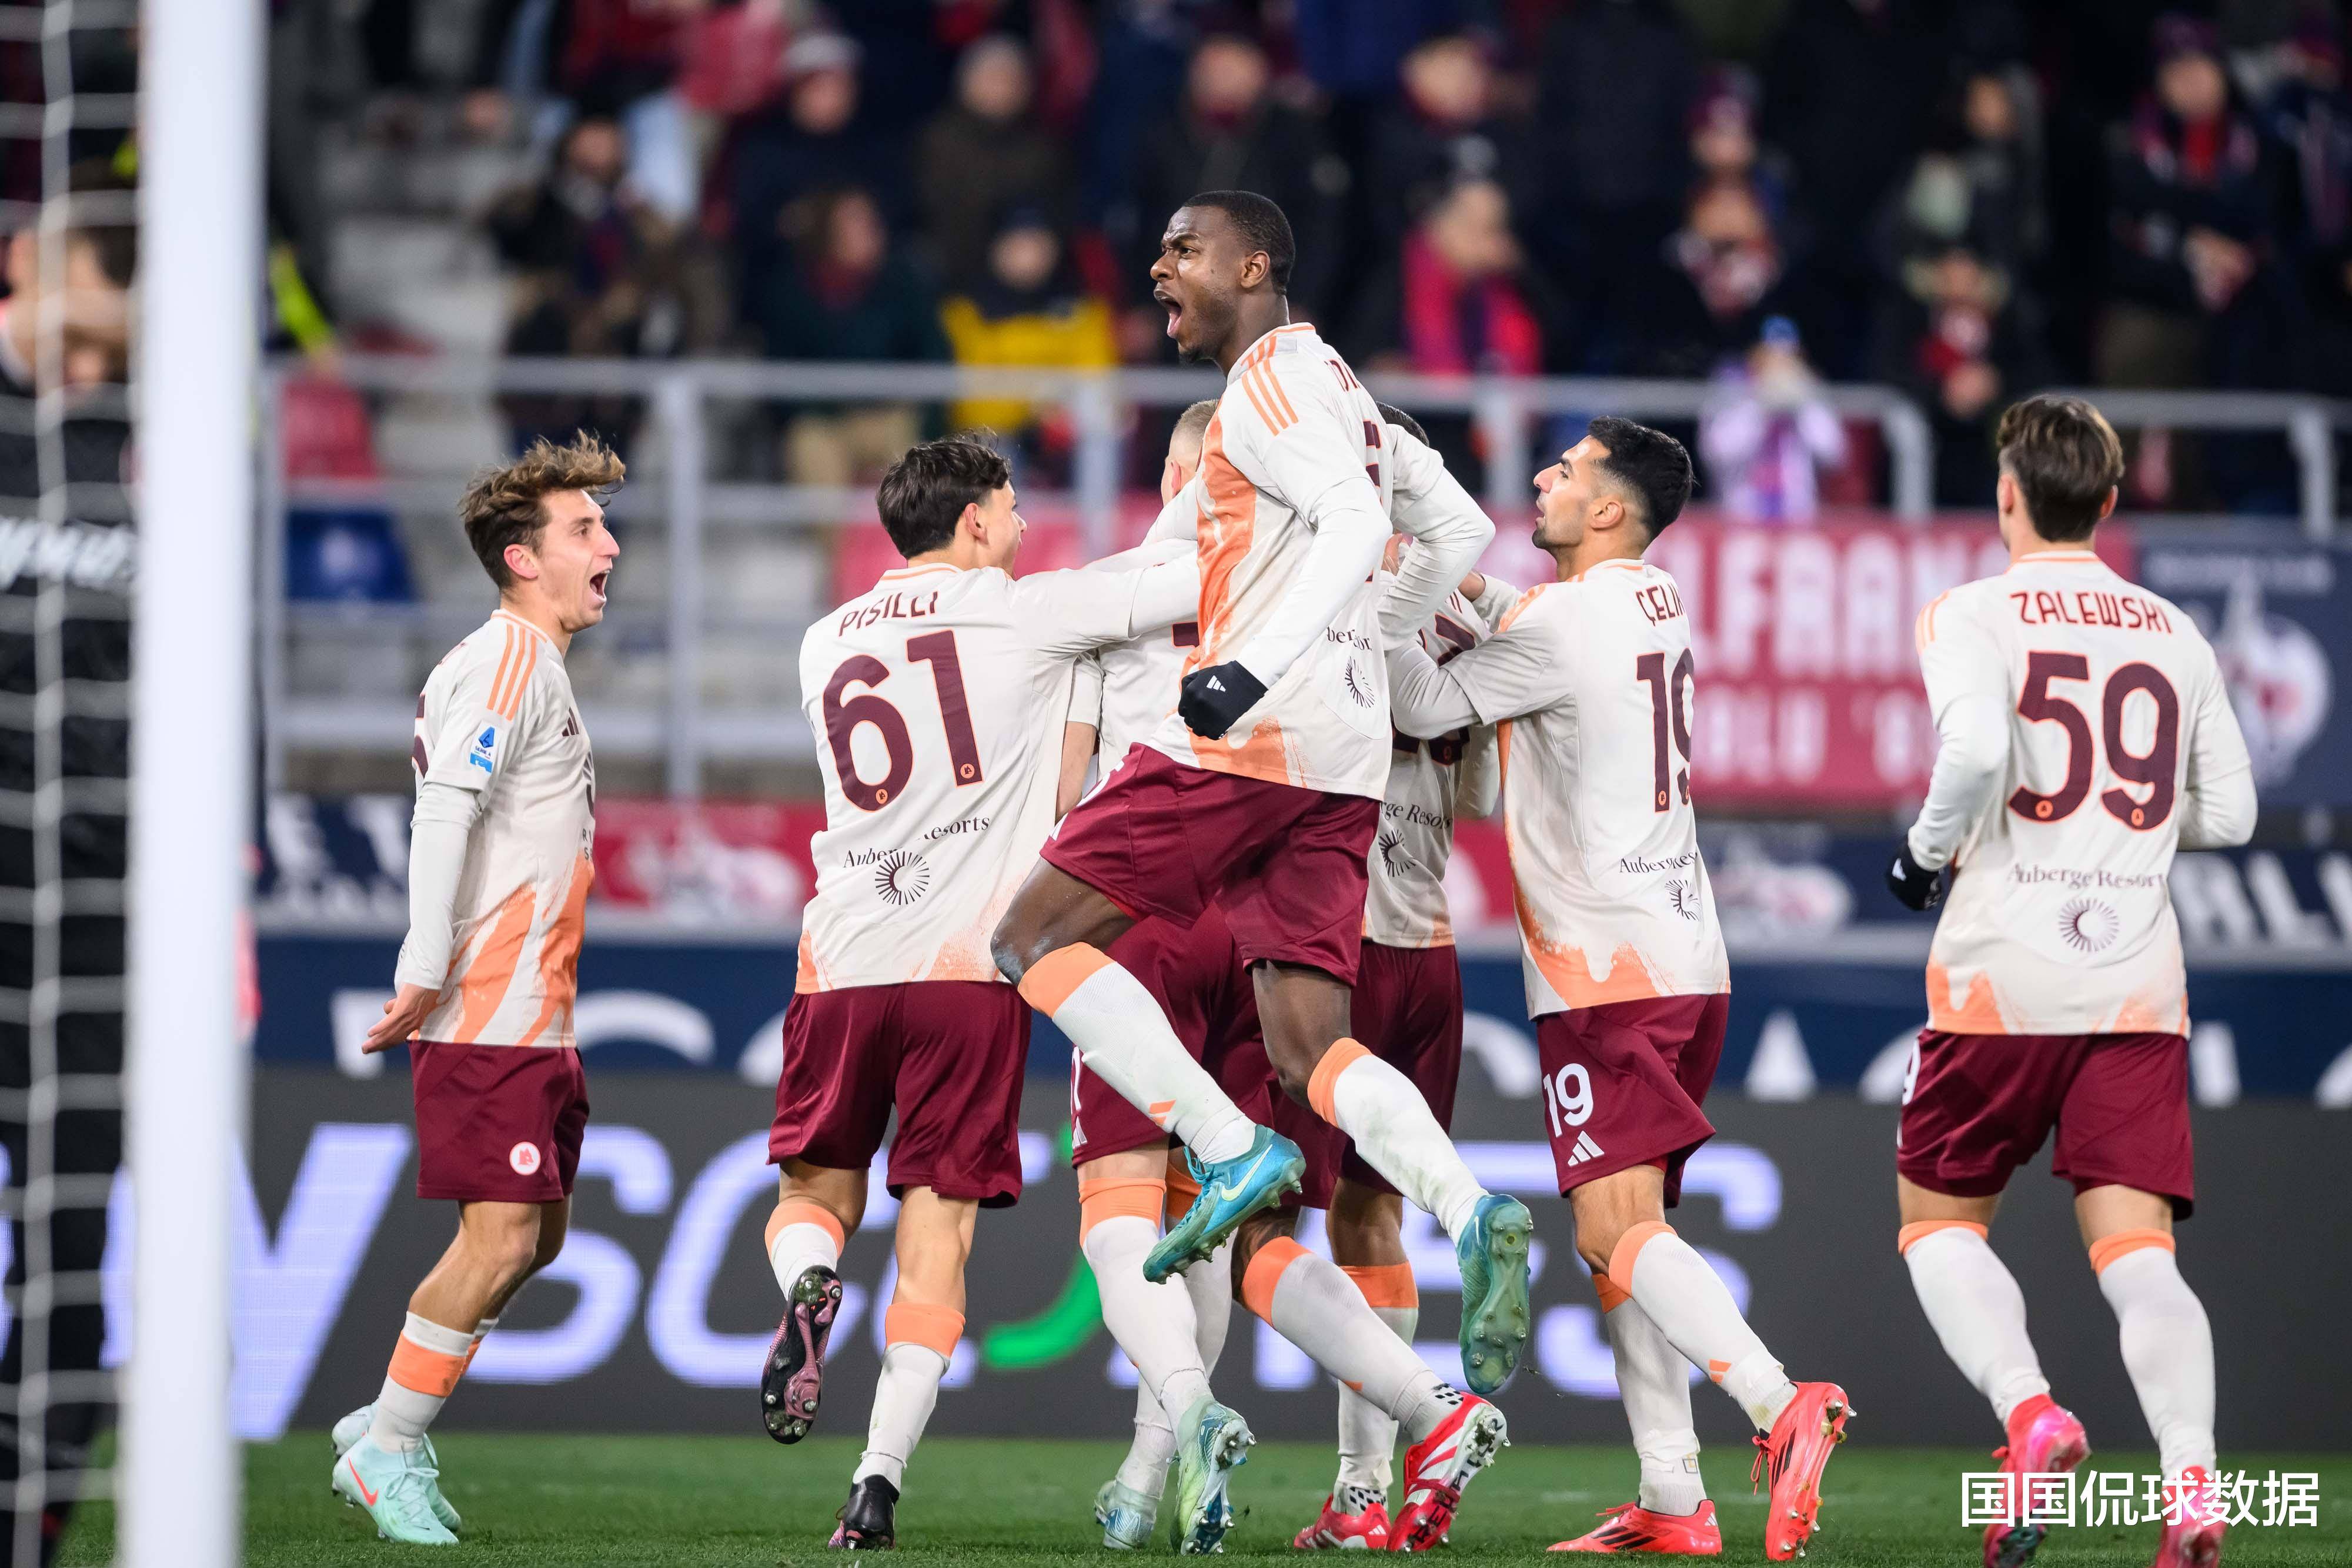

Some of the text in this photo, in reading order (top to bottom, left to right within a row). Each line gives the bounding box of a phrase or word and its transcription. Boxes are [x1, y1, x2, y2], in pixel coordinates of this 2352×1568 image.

[838, 590, 938, 637] PISILLI
[2010, 590, 2171, 634] ZALEWSKI
[475, 745, 487, 754] SERIE
[823, 628, 984, 813] 61
[1636, 647, 1695, 813] 19
[2007, 650, 2179, 832] 59
[1543, 1063, 1594, 1138] 19
